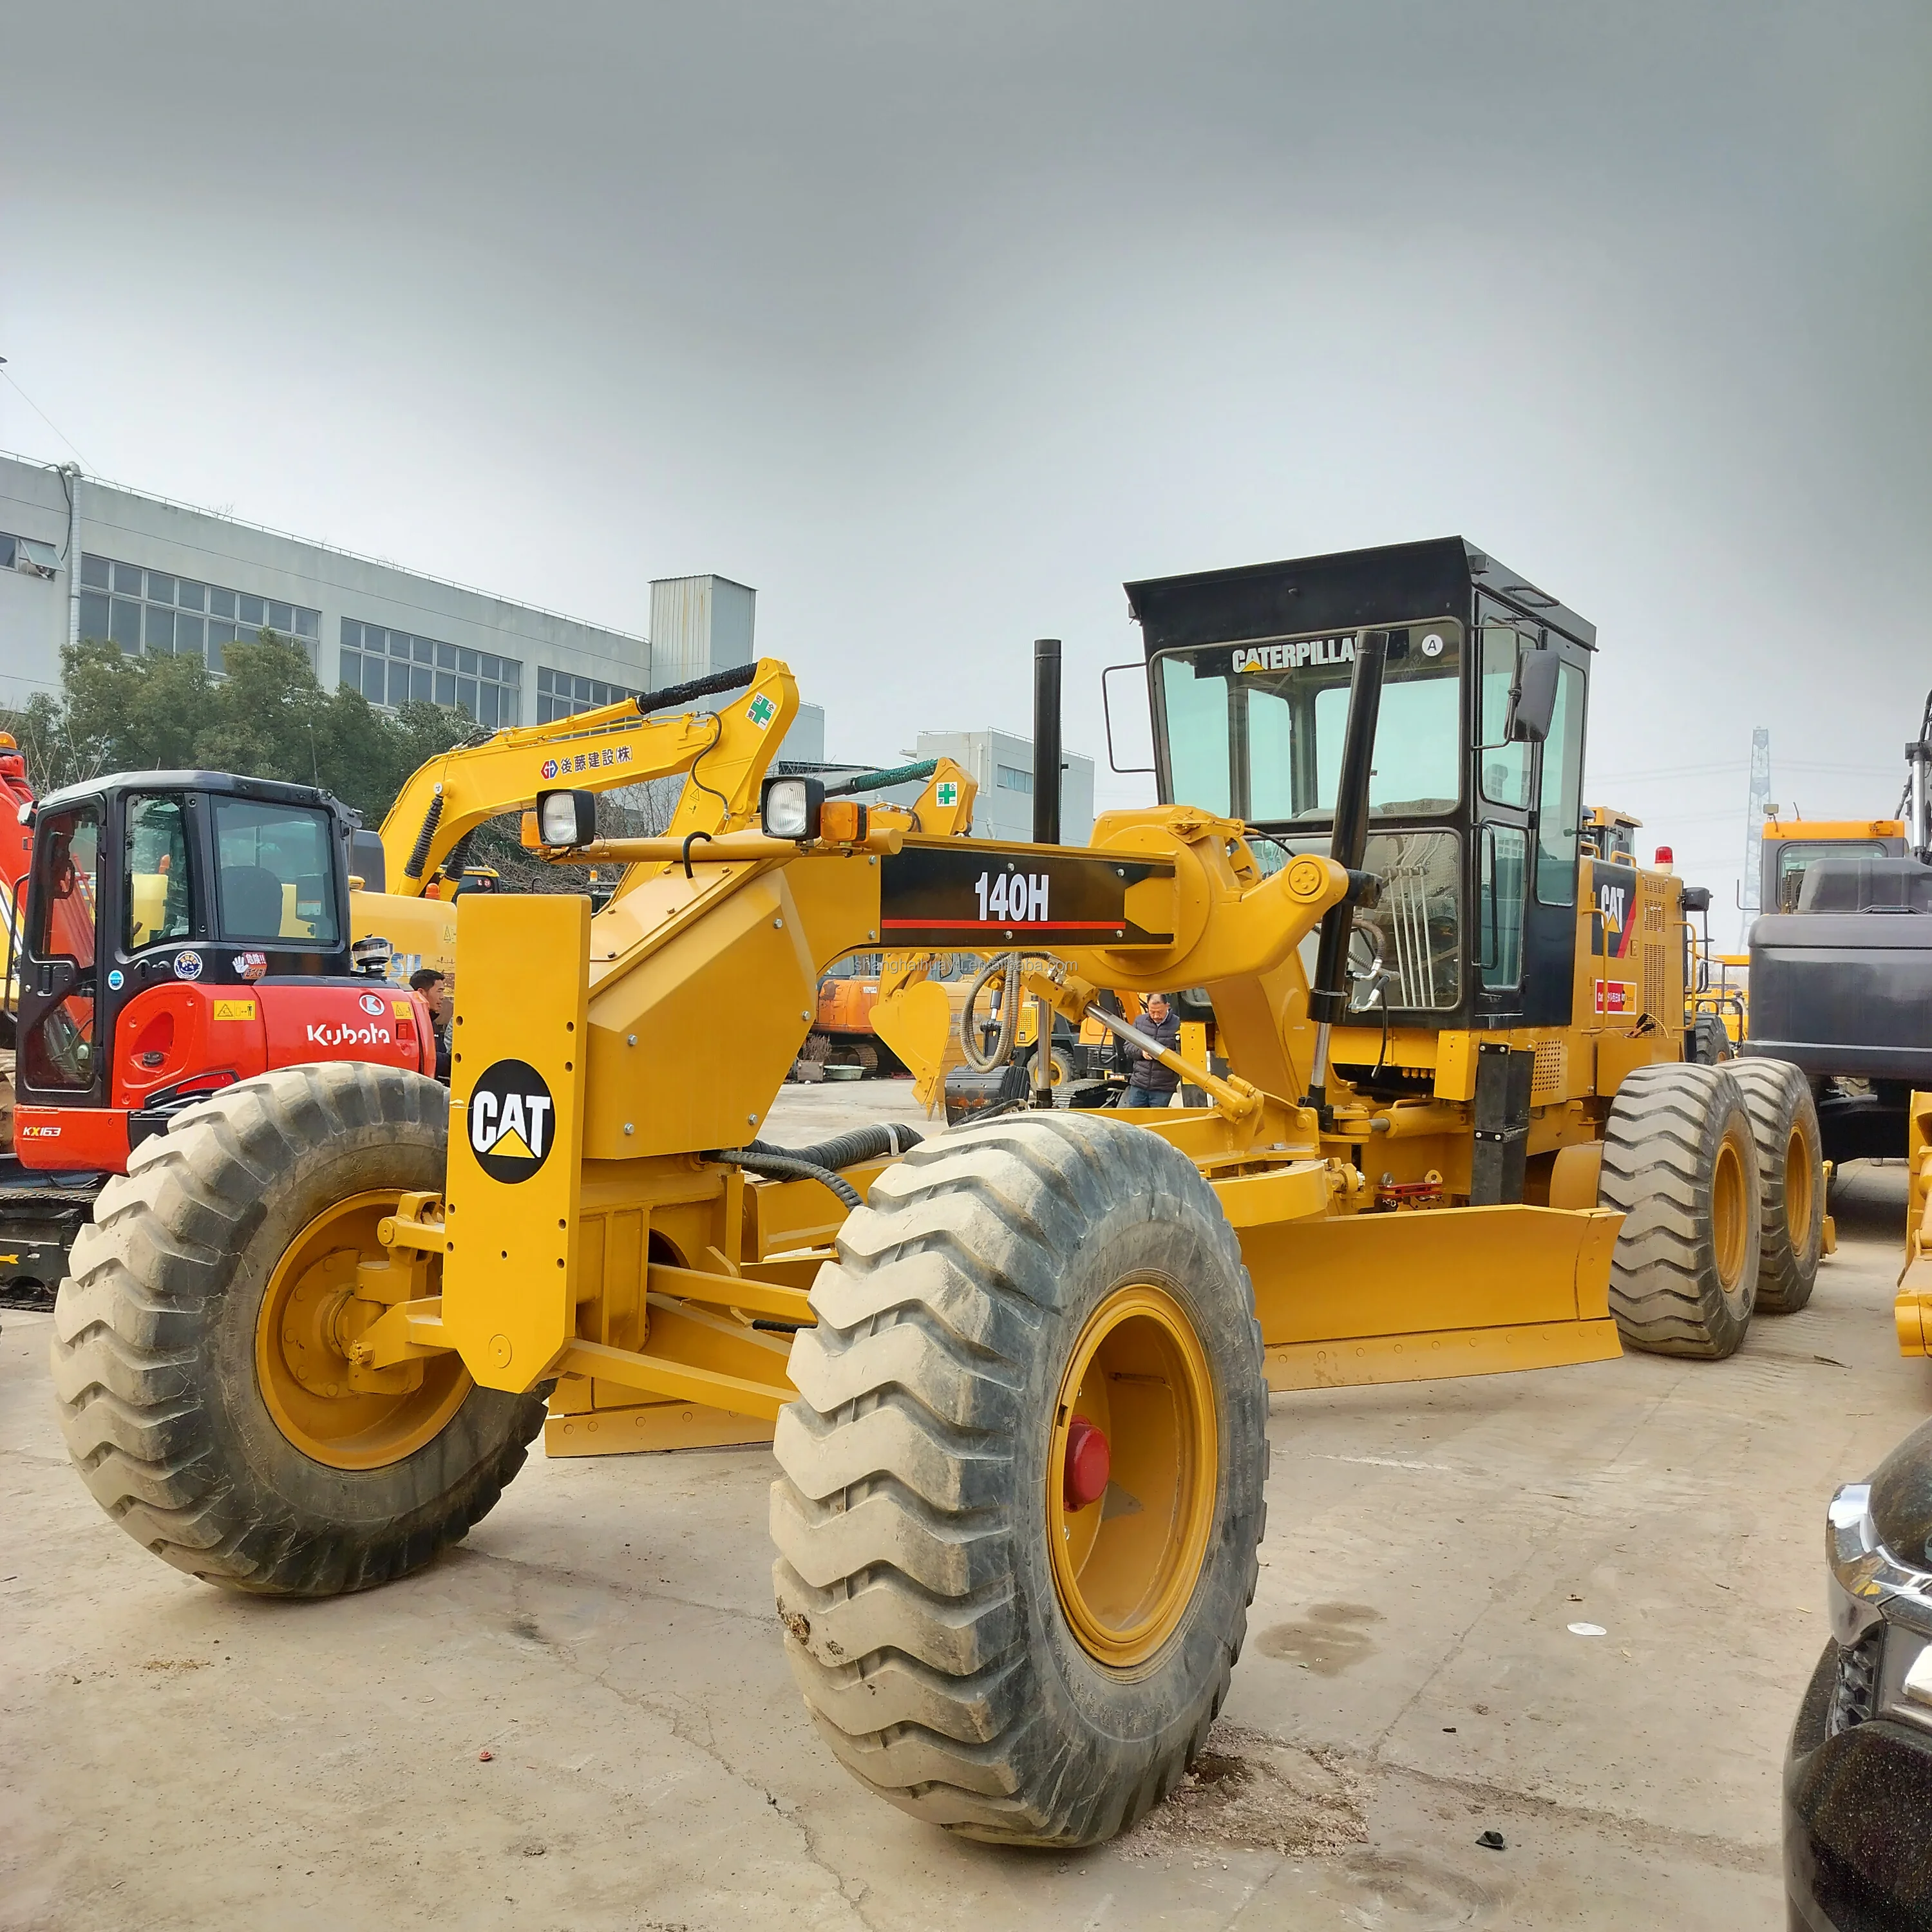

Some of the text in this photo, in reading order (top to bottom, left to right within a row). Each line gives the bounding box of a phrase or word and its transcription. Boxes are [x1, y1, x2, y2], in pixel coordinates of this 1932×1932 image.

[1233, 637, 1358, 674] CATERPILLA
[1427, 639, 1437, 651] A
[975, 872, 1049, 922] 140H
[1601, 884, 1625, 933] CAT
[307, 1023, 390, 1046] Kubota
[23, 1126, 61, 1137] KX163
[472, 1090, 551, 1158] CAT
